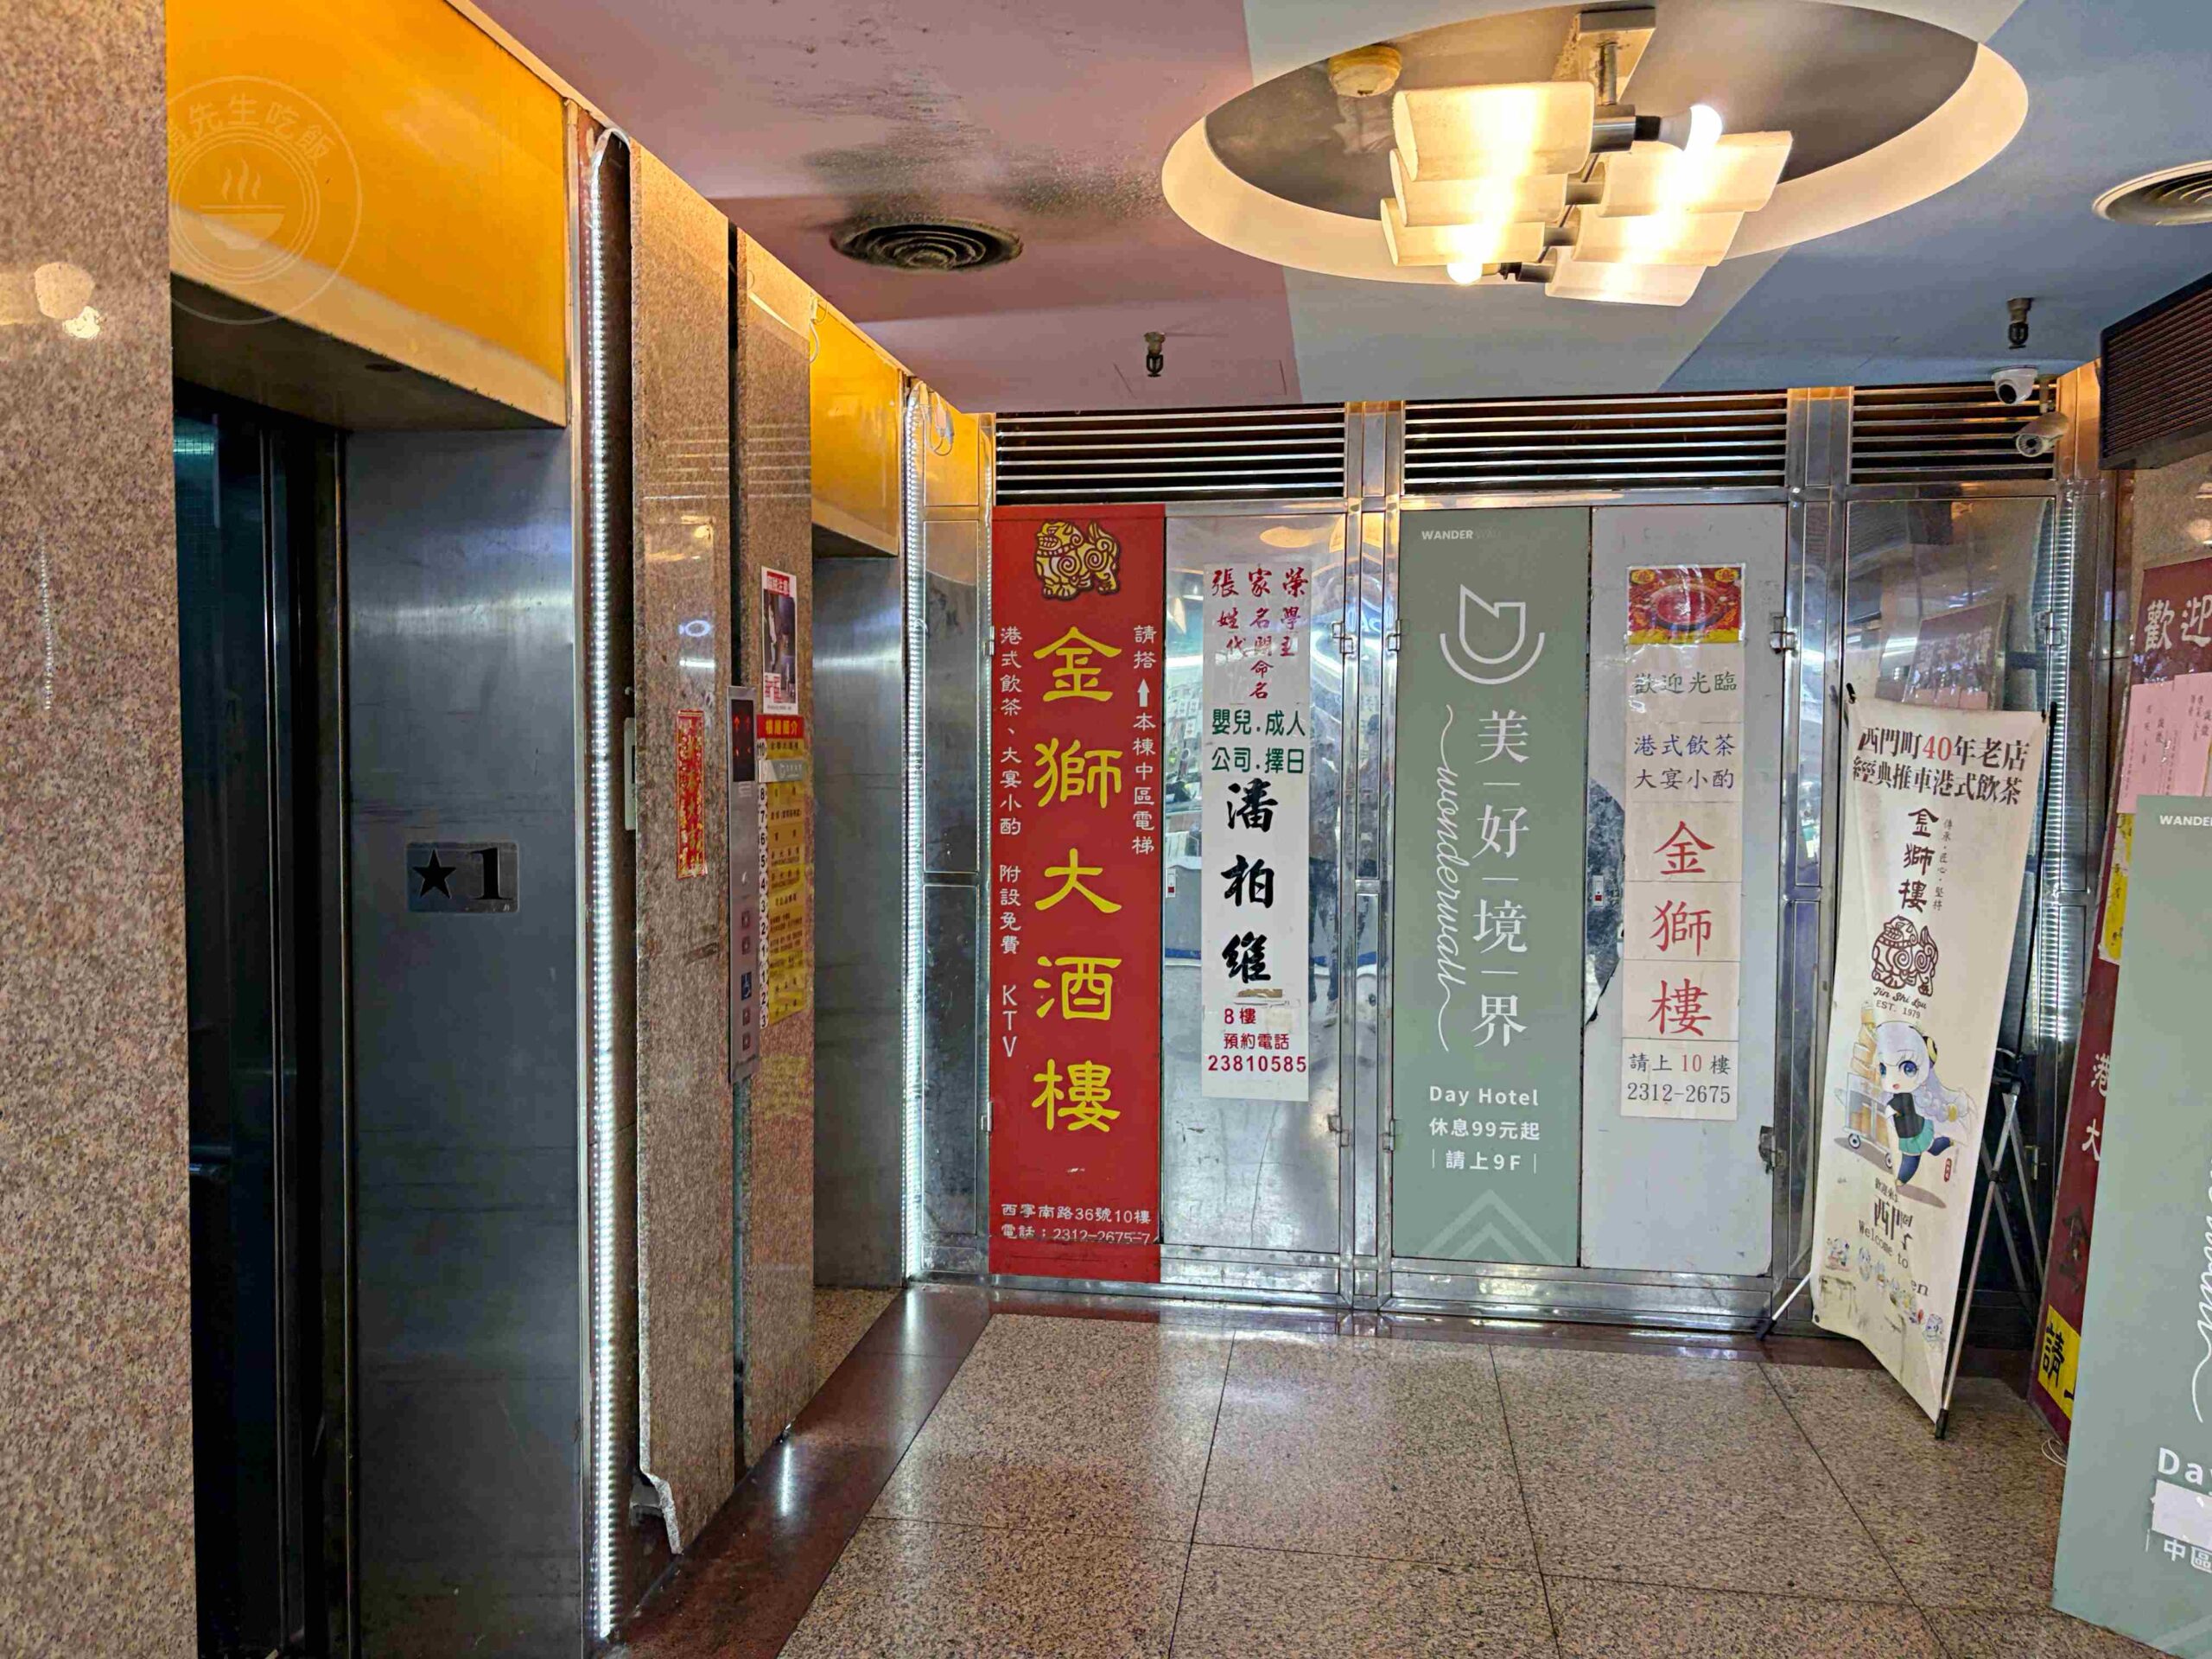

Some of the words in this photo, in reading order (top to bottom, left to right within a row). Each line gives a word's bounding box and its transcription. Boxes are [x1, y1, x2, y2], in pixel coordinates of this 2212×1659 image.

[1211, 567, 1309, 598] 張家榮
[1217, 606, 1301, 630] 姓名學
[2144, 594, 2212, 652] 歡迎
[1133, 625, 1157, 670] 請搭
[1633, 671, 1738, 695] 歡迎光臨
[1000, 626, 1023, 836] 港式飲茶、大宴小酌
[1633, 734, 1737, 757] 港式飲茶
[1858, 727, 2030, 772] 西門町40年老店
[1131, 713, 1157, 855] 本棟中區電梯
[1633, 767, 1735, 790] 大宴小酌
[1853, 755, 2023, 805] 經典推車港式飲茶
[2159, 815, 2212, 826] WANDE
[1898, 808, 1939, 913] 金獅樓
[472, 847, 516, 900] 1
[1032, 626, 1122, 1134] 金獅大酒樓
[1221, 778, 1279, 984] 潘柏維
[999, 864, 1022, 955] 附設免費
[1648, 821, 1716, 1037] 金獅樓
[1892, 991, 1911, 1002] Shi
[1001, 984, 1018, 1058] KTV
[1224, 1007, 1257, 1025] 8樓
[1902, 1007, 1921, 1019] 1979
[1223, 1033, 1290, 1051] 預約電話
[1207, 1054, 1307, 1073] 23810585
[1629, 1052, 1732, 1075] 請上10樓
[1429, 1085, 1470, 1107] Day
[1478, 1087, 1539, 1106] Hotel
[1626, 1082, 1732, 1104] 2312-2675
[1429, 1116, 1541, 1141] 休息99元起
[1445, 1149, 1522, 1171] 請上9F
[1001, 1203, 1152, 1224] 西寧南路36號10樓
[1858, 1218, 1893, 1257] Welcome
[1897, 1252, 1909, 1269] to
[1910, 1280, 1929, 1297] en
[2158, 1446, 2212, 1486] Da
